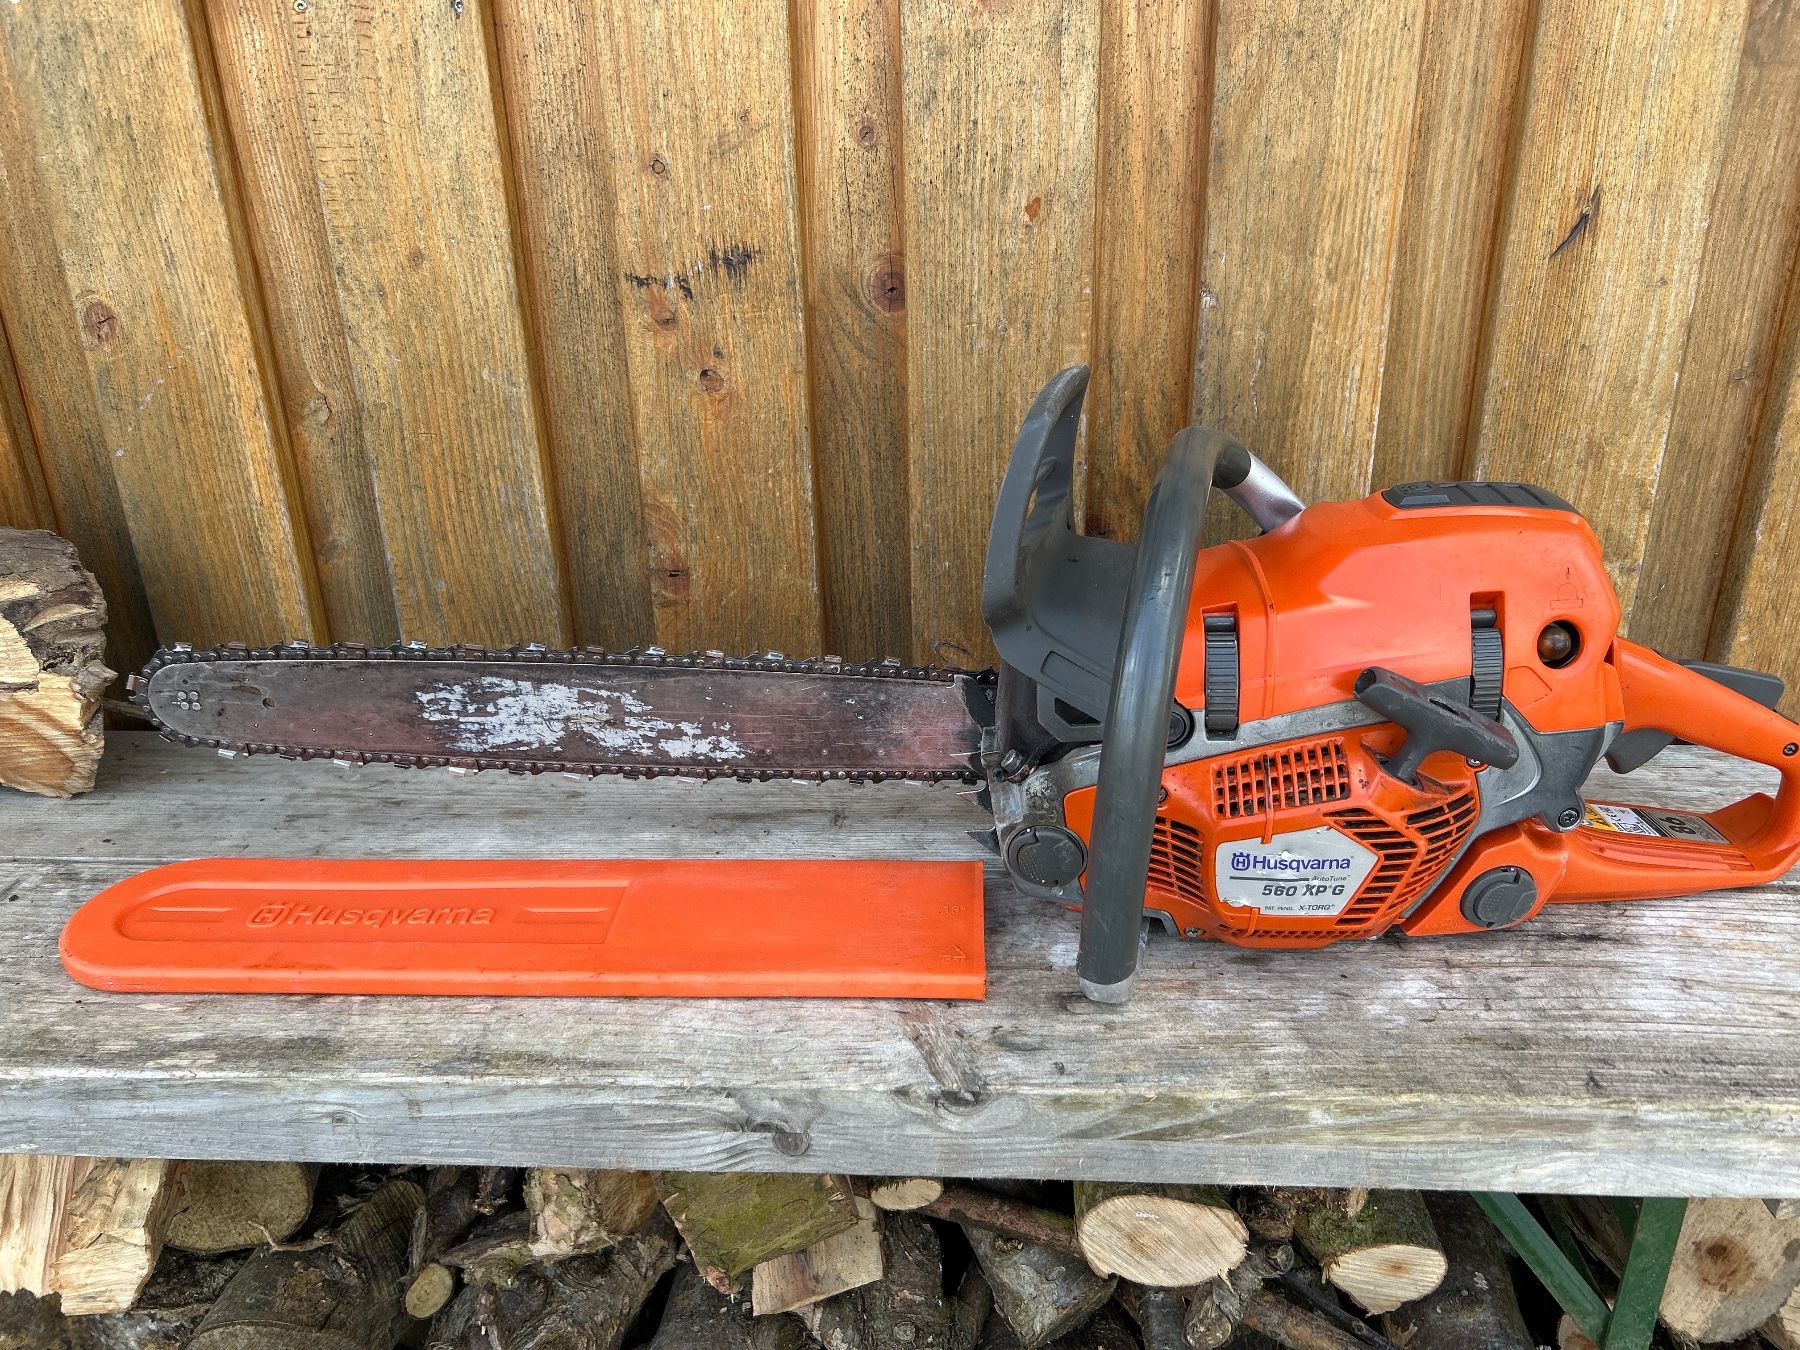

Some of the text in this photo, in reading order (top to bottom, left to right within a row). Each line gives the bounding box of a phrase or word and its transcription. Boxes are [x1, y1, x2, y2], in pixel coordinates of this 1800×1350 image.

[1253, 855, 1351, 872] Husqvarna
[1261, 884, 1298, 896] 560
[286, 903, 497, 928] Husqvarna
